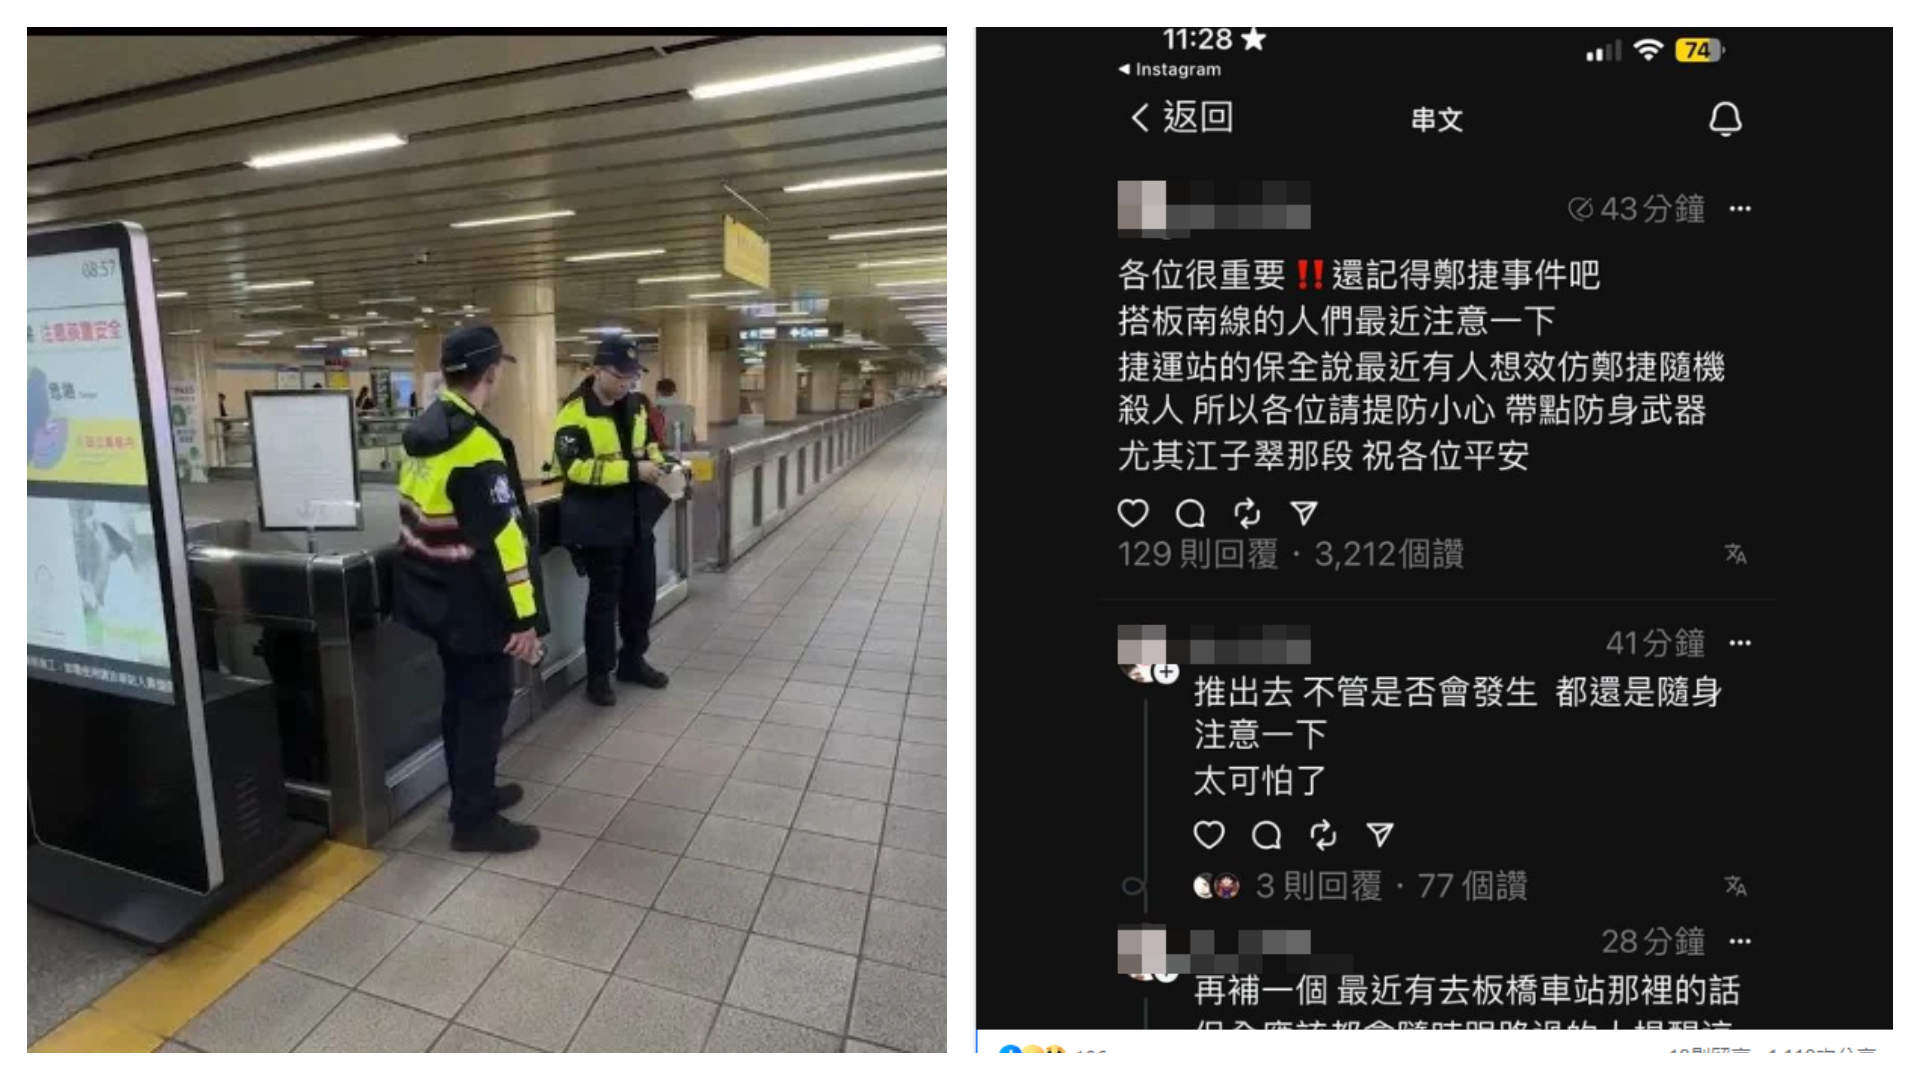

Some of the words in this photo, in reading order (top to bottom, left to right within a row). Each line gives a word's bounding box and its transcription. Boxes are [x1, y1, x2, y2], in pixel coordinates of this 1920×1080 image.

[1162, 27, 1233, 51] 11:28
[1685, 41, 1711, 59] 74
[1136, 62, 1222, 80] Instagram
[1163, 99, 1233, 134] 返回
[1411, 106, 1464, 134] 串文
[1117, 303, 1556, 338] 搭板南線的人們最近注意一下
[1118, 349, 1726, 383] 捷運站的保全說最近有人想效仿鄭捷隨機
[1118, 392, 1184, 427] 殺人
[1192, 392, 1496, 427] 所以各位請提防小心
[1505, 392, 1707, 427] 帶點防身武器
[1118, 438, 1354, 472] 尤其江子翠那段
[1361, 438, 1530, 472] 祝各位平安
[1118, 541, 1172, 567] 129
[1193, 674, 1294, 708] 推出去
[1303, 674, 1539, 708] 不管是否會發生
[1555, 674, 1723, 708] 都還是隨身
[1194, 717, 1328, 751] 注意一下
[1193, 763, 1326, 797] 太可怕了
[1194, 974, 1328, 1006] 再補一個
[1337, 974, 1741, 1006] 最近有去板橋車站那裡的話
